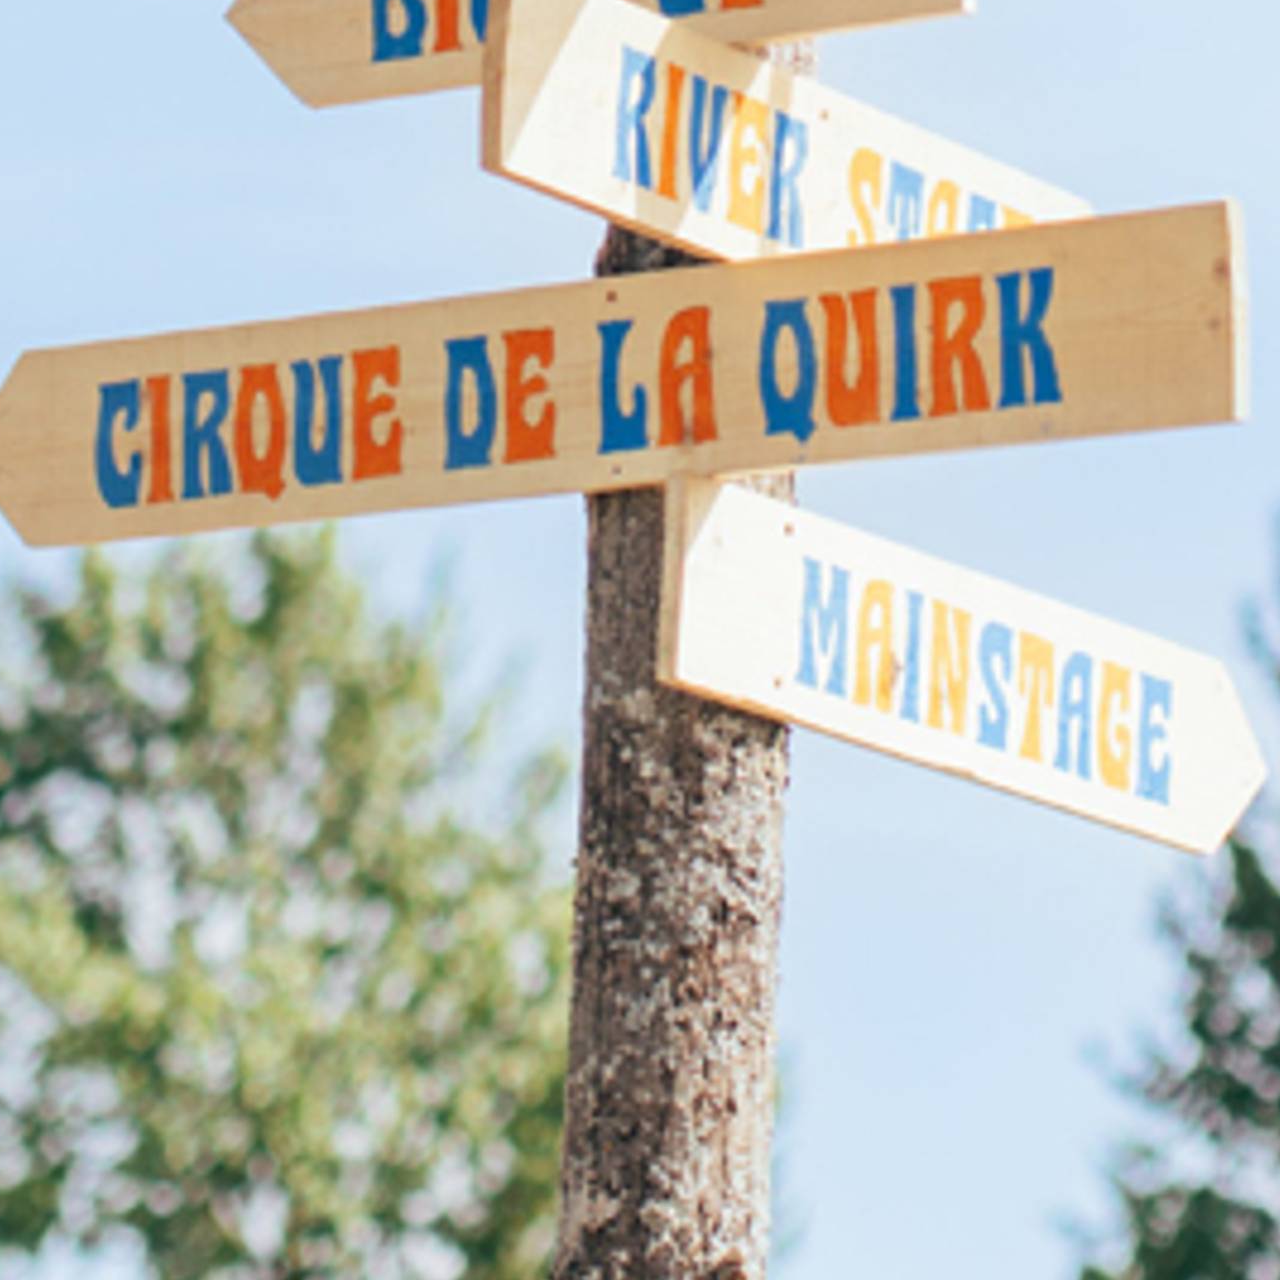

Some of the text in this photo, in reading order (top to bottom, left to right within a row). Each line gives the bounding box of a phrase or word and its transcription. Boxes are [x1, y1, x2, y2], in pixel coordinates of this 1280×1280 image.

[611, 43, 809, 249] RIVER
[95, 266, 1063, 509] CIRQUE DE LA QUIRK
[794, 555, 1173, 807] MAINSTAGE
